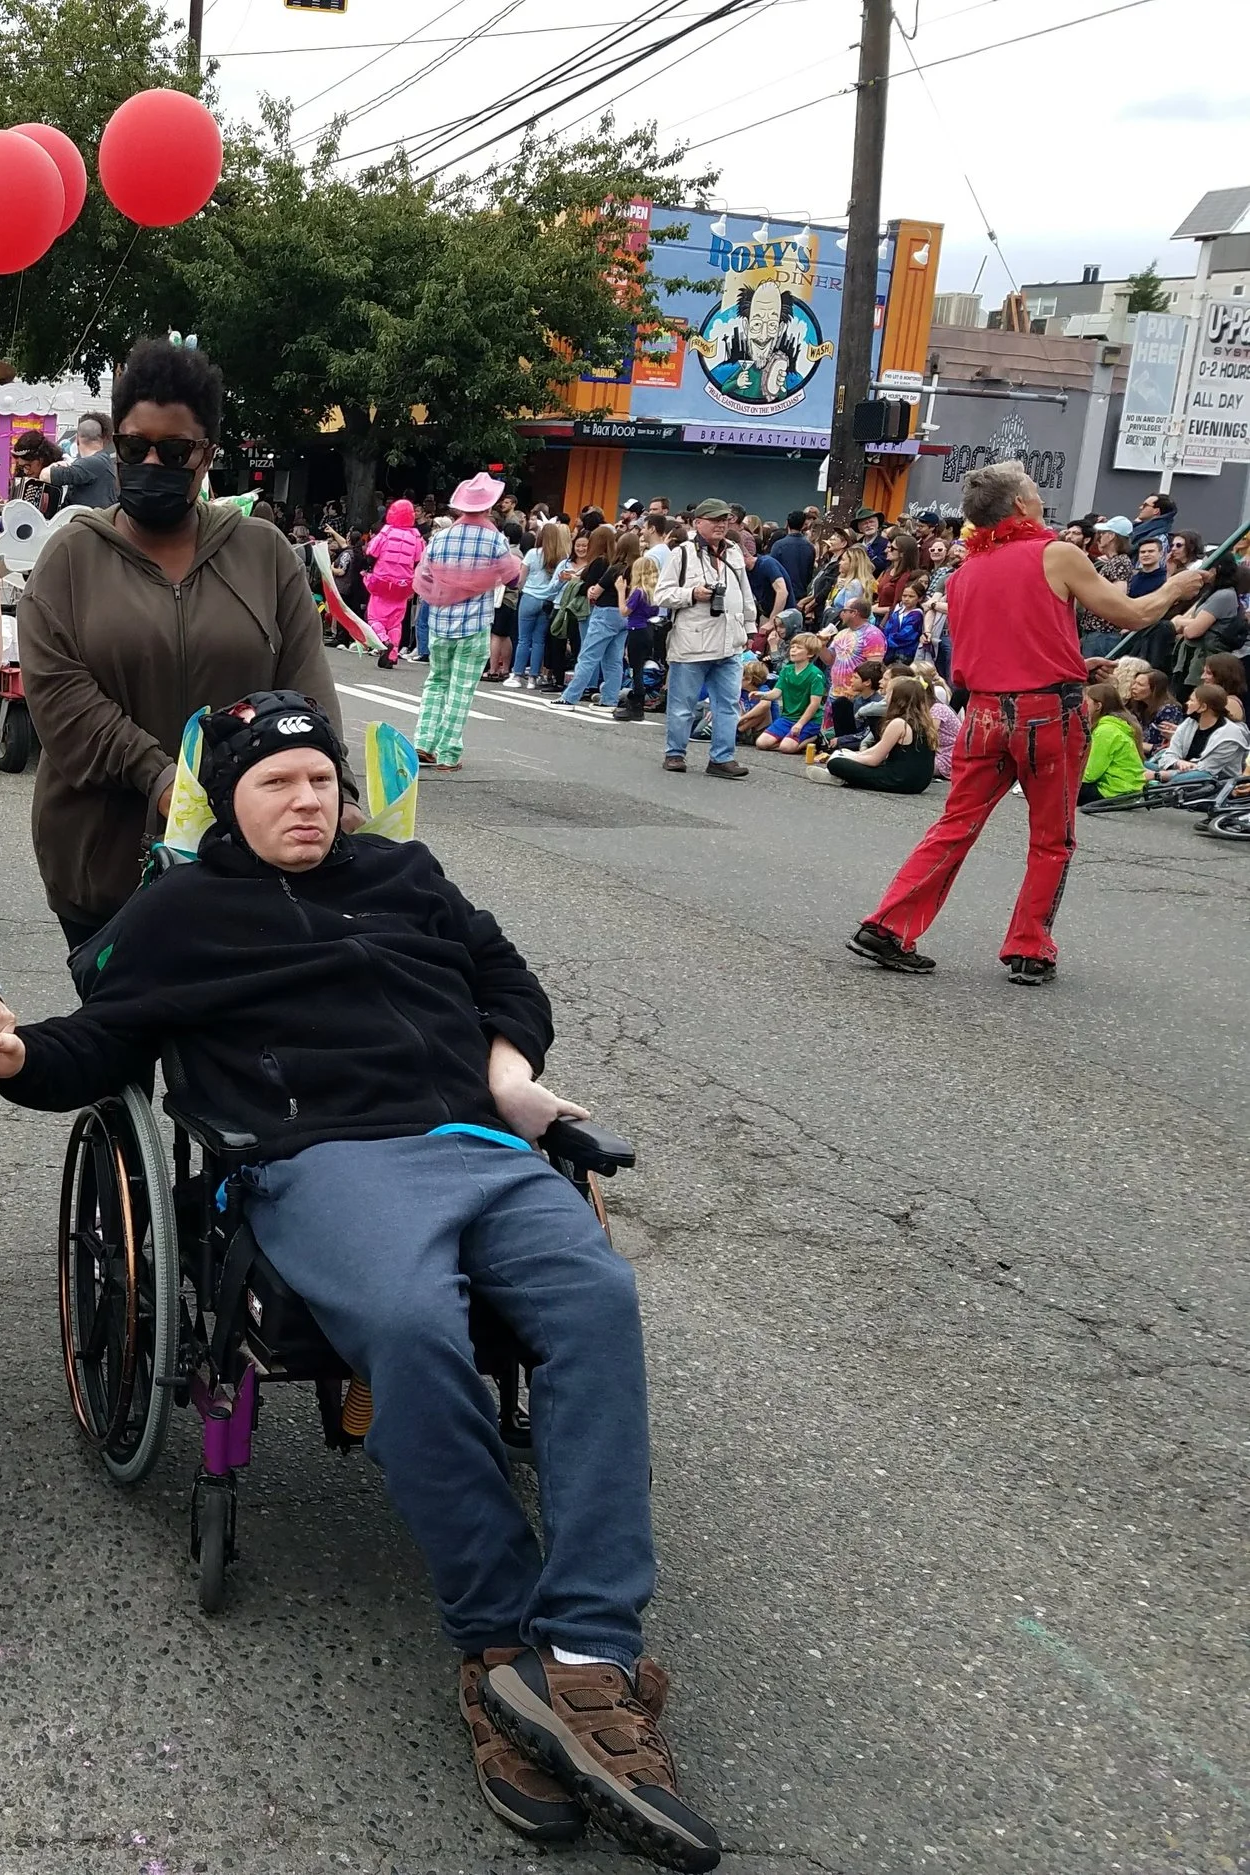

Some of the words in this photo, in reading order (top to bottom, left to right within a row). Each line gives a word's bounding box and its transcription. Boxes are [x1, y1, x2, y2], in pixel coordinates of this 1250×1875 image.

[707, 233, 812, 273] ROXY'S
[775, 270, 843, 291] DINER
[1146, 318, 1179, 340] PAY
[691, 338, 714, 353] FREMONT
[1136, 343, 1180, 364] HERE
[1199, 361, 1218, 377] 0-2
[1220, 362, 1250, 380] HOURS
[1193, 392, 1214, 408] ALL
[1218, 393, 1244, 410] DAY
[1126, 414, 1135, 422] NO
[1129, 423, 1162, 432] PRIVILEGES
[592, 423, 611, 436] BACK
[612, 424, 636, 437] DOOR
[700, 429, 781, 445] BREAKFAST
[792, 436, 828, 448] LUNC
[1188, 419, 1248, 439] EVENINGS
[249, 459, 275, 468] PIZZA
